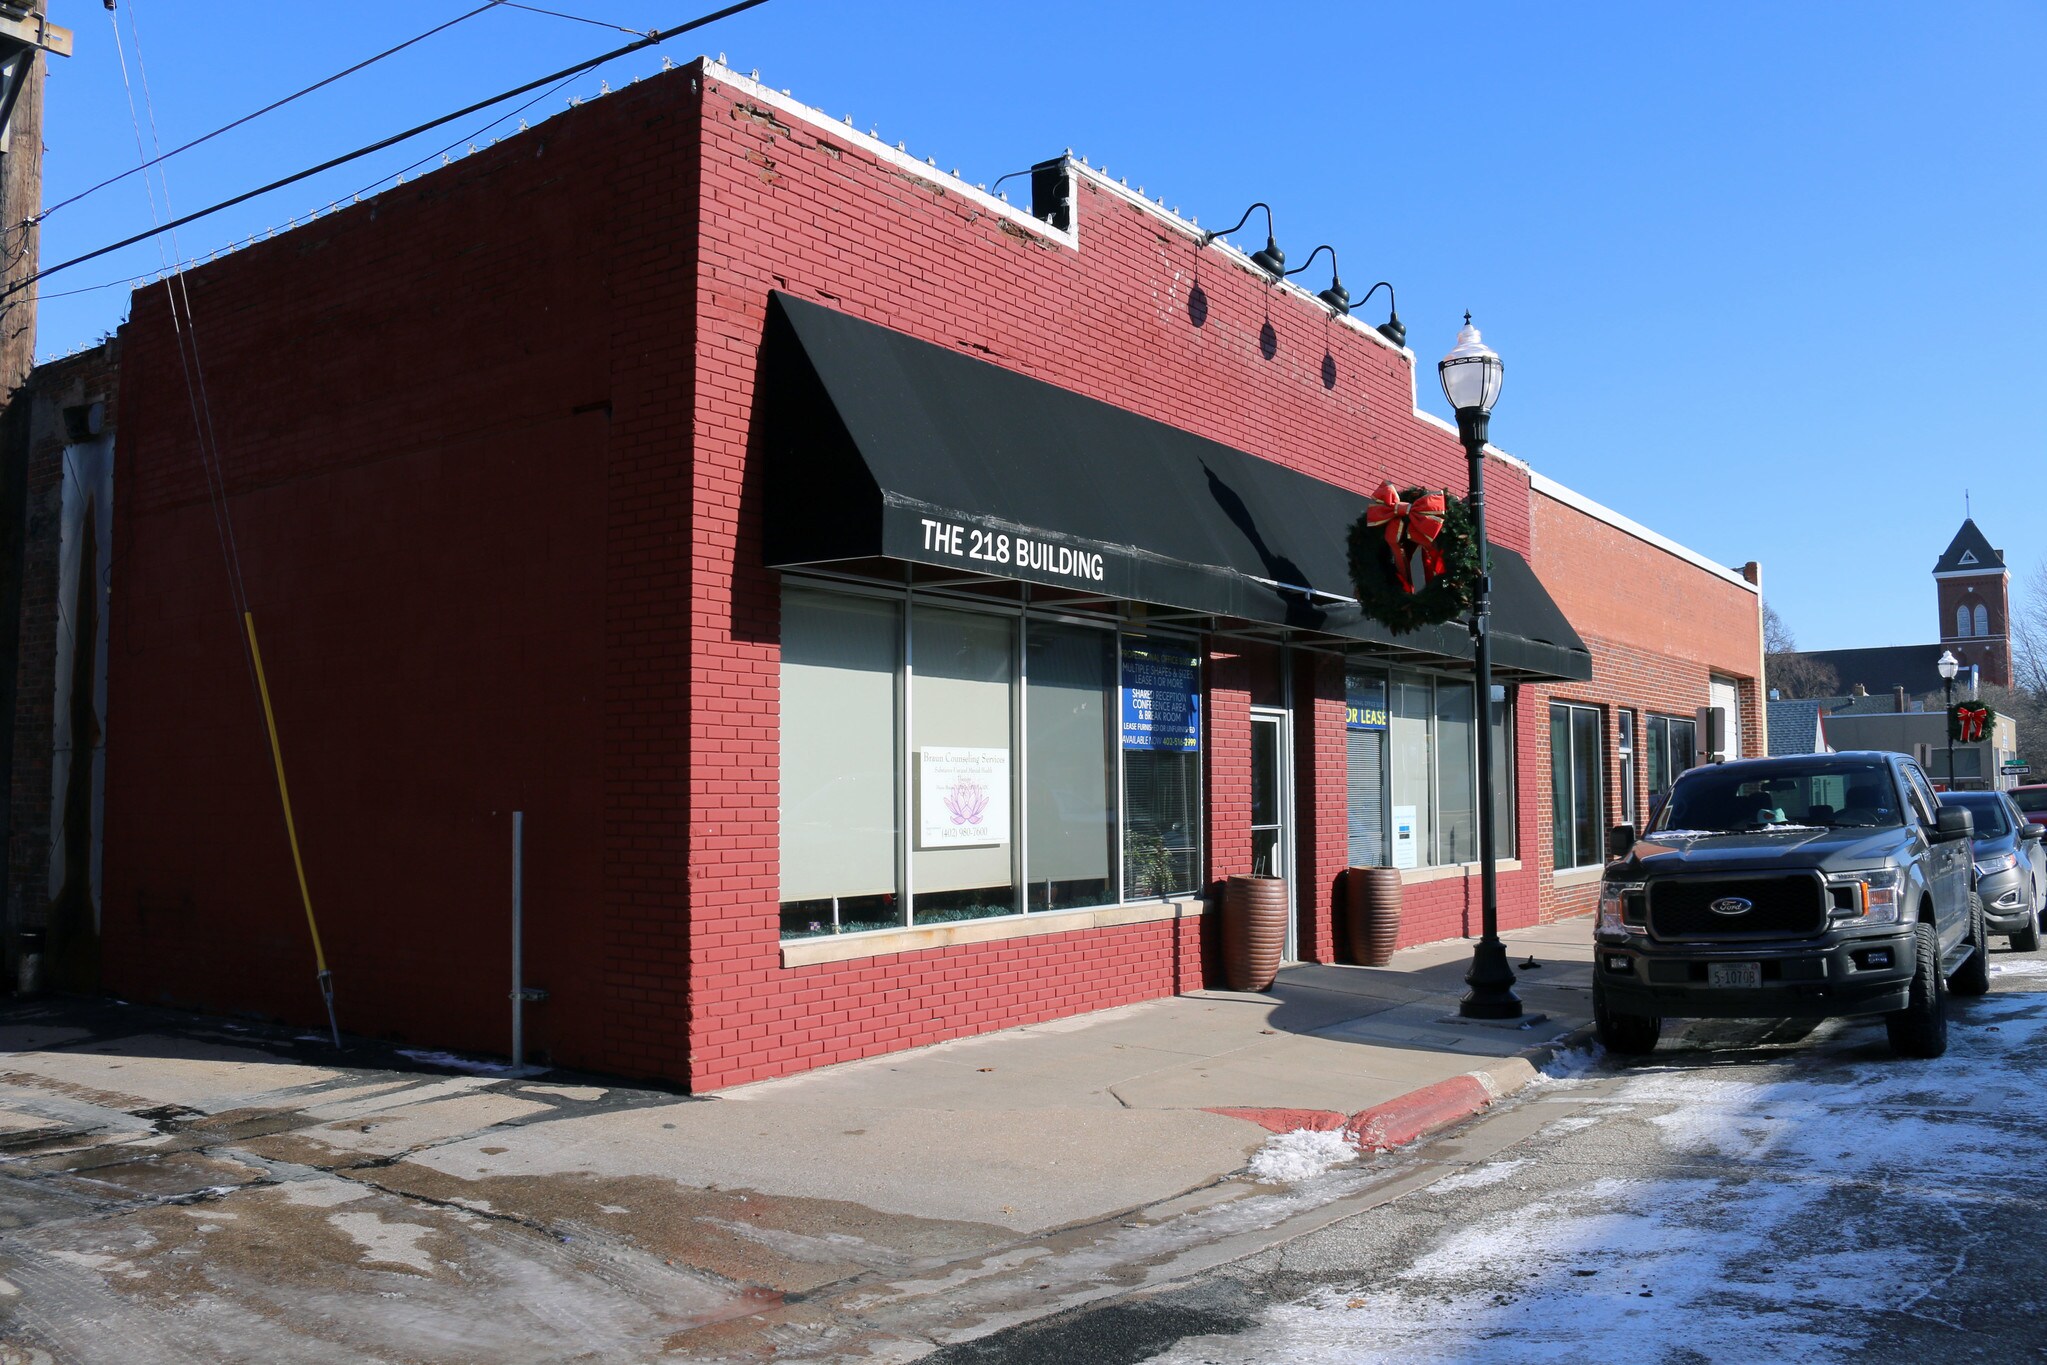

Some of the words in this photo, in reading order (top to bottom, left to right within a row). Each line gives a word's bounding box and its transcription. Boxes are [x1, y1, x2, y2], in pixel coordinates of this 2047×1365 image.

[921, 518, 964, 556] THE
[969, 529, 1010, 563] 218
[1016, 538, 1104, 581] BUILDING
[1122, 661, 1149, 675] MULTIPLE
[1151, 665, 1172, 678] SHAPES
[1135, 674, 1152, 686] LEASE
[1158, 678, 1166, 686] OR
[1167, 678, 1184, 689] MORE
[1132, 688, 1154, 700] SHARED
[1155, 691, 1187, 703] RECEPTION
[1132, 698, 1171, 711] CONFERENCE
[1171, 702, 1187, 713] AREA
[1138, 710, 1144, 720] &
[1144, 710, 1162, 721] BREAK
[1162, 712, 1181, 722] ROOM
[1346, 708, 1358, 723] OR
[1361, 709, 1386, 725] LEASE
[1123, 722, 1137, 731] LEASE
[1122, 734, 1149, 745] AVAILABLE
[923, 751, 944, 763] Braun
[945, 751, 980, 765] Counseling
[981, 752, 1005, 764] Services
[941, 828, 958, 840] (402)
[1720, 900, 1742, 911] Ford
